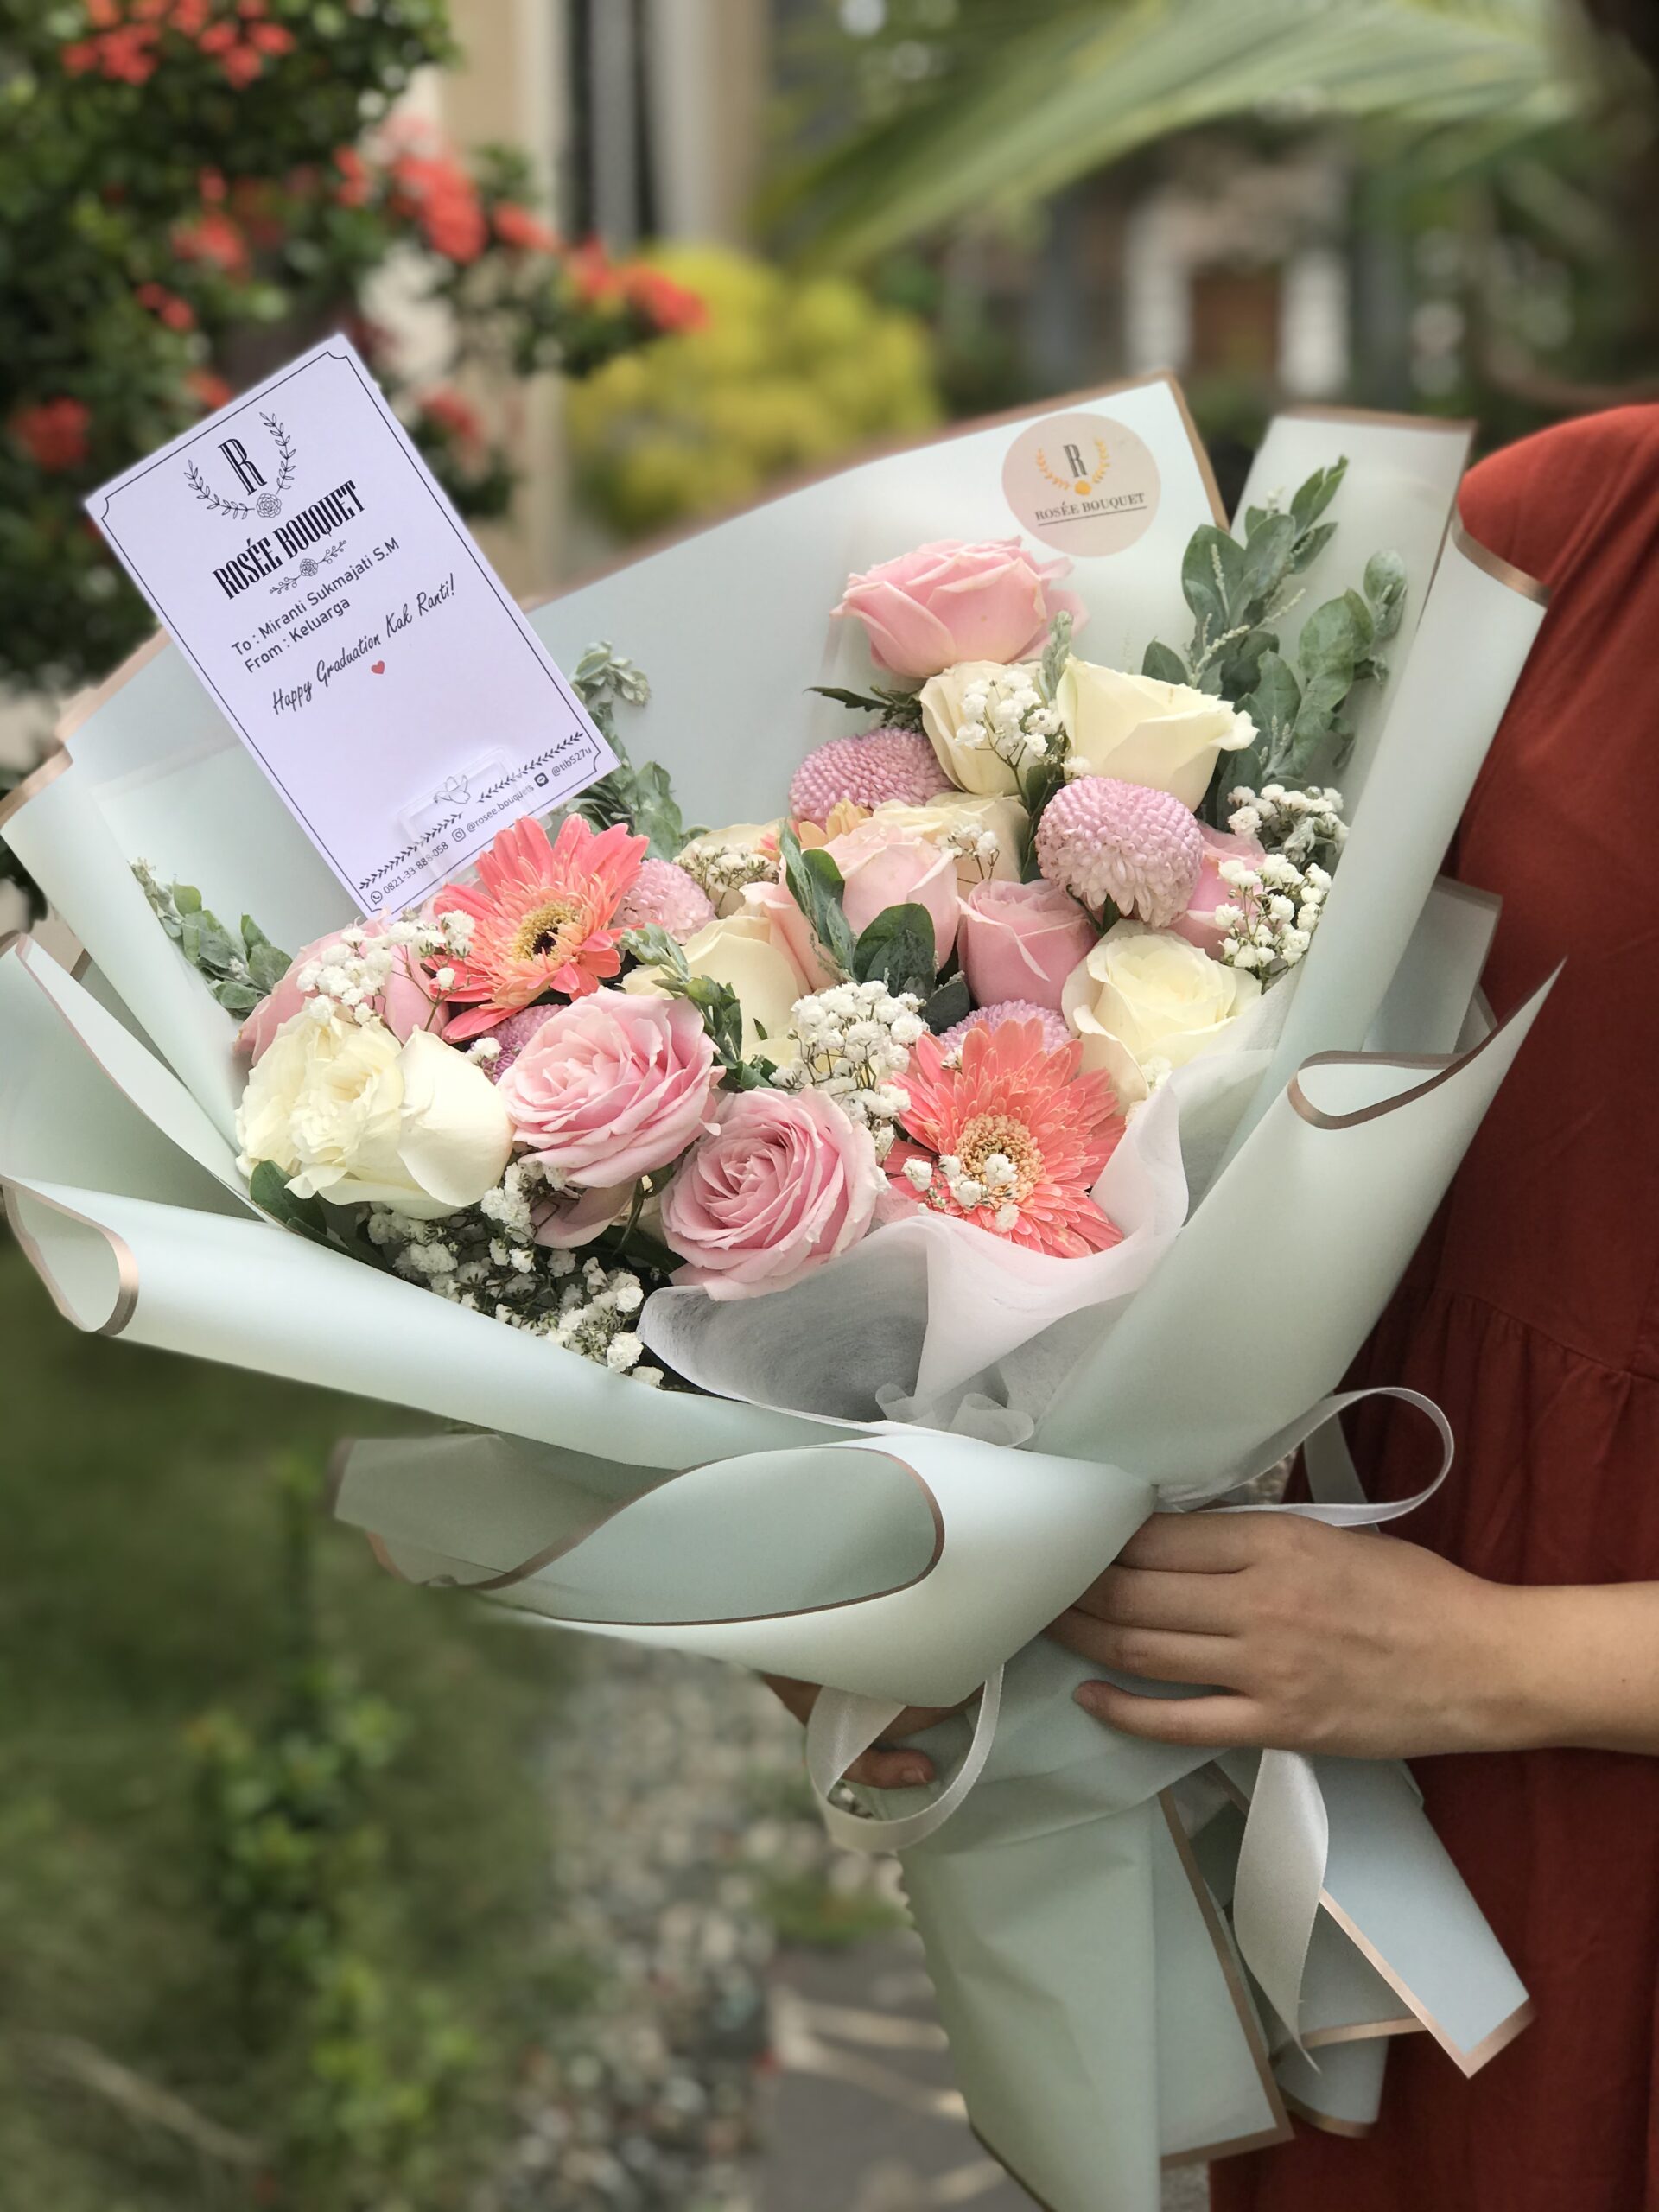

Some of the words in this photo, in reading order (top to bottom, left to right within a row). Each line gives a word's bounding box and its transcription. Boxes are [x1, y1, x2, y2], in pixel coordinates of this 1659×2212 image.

[218, 439, 268, 496] R
[1063, 444, 1088, 478] R
[213, 537, 283, 600] ROSÉE
[272, 480, 365, 559] BOUQUET
[1034, 501, 1080, 520] ROSÉE
[1082, 493, 1145, 512] BOUQUET
[232, 640, 252, 656] To
[258, 600, 307, 639] Miranti
[307, 555, 373, 606] Sukmajati
[373, 537, 399, 561] S.M
[245, 645, 283, 673] From
[289, 599, 350, 643] Keluarga
[273, 681, 312, 715] Happy
[317, 634, 381, 687] Graduation
[386, 603, 412, 638] Kak
[416, 573, 454, 616] Ranti!
